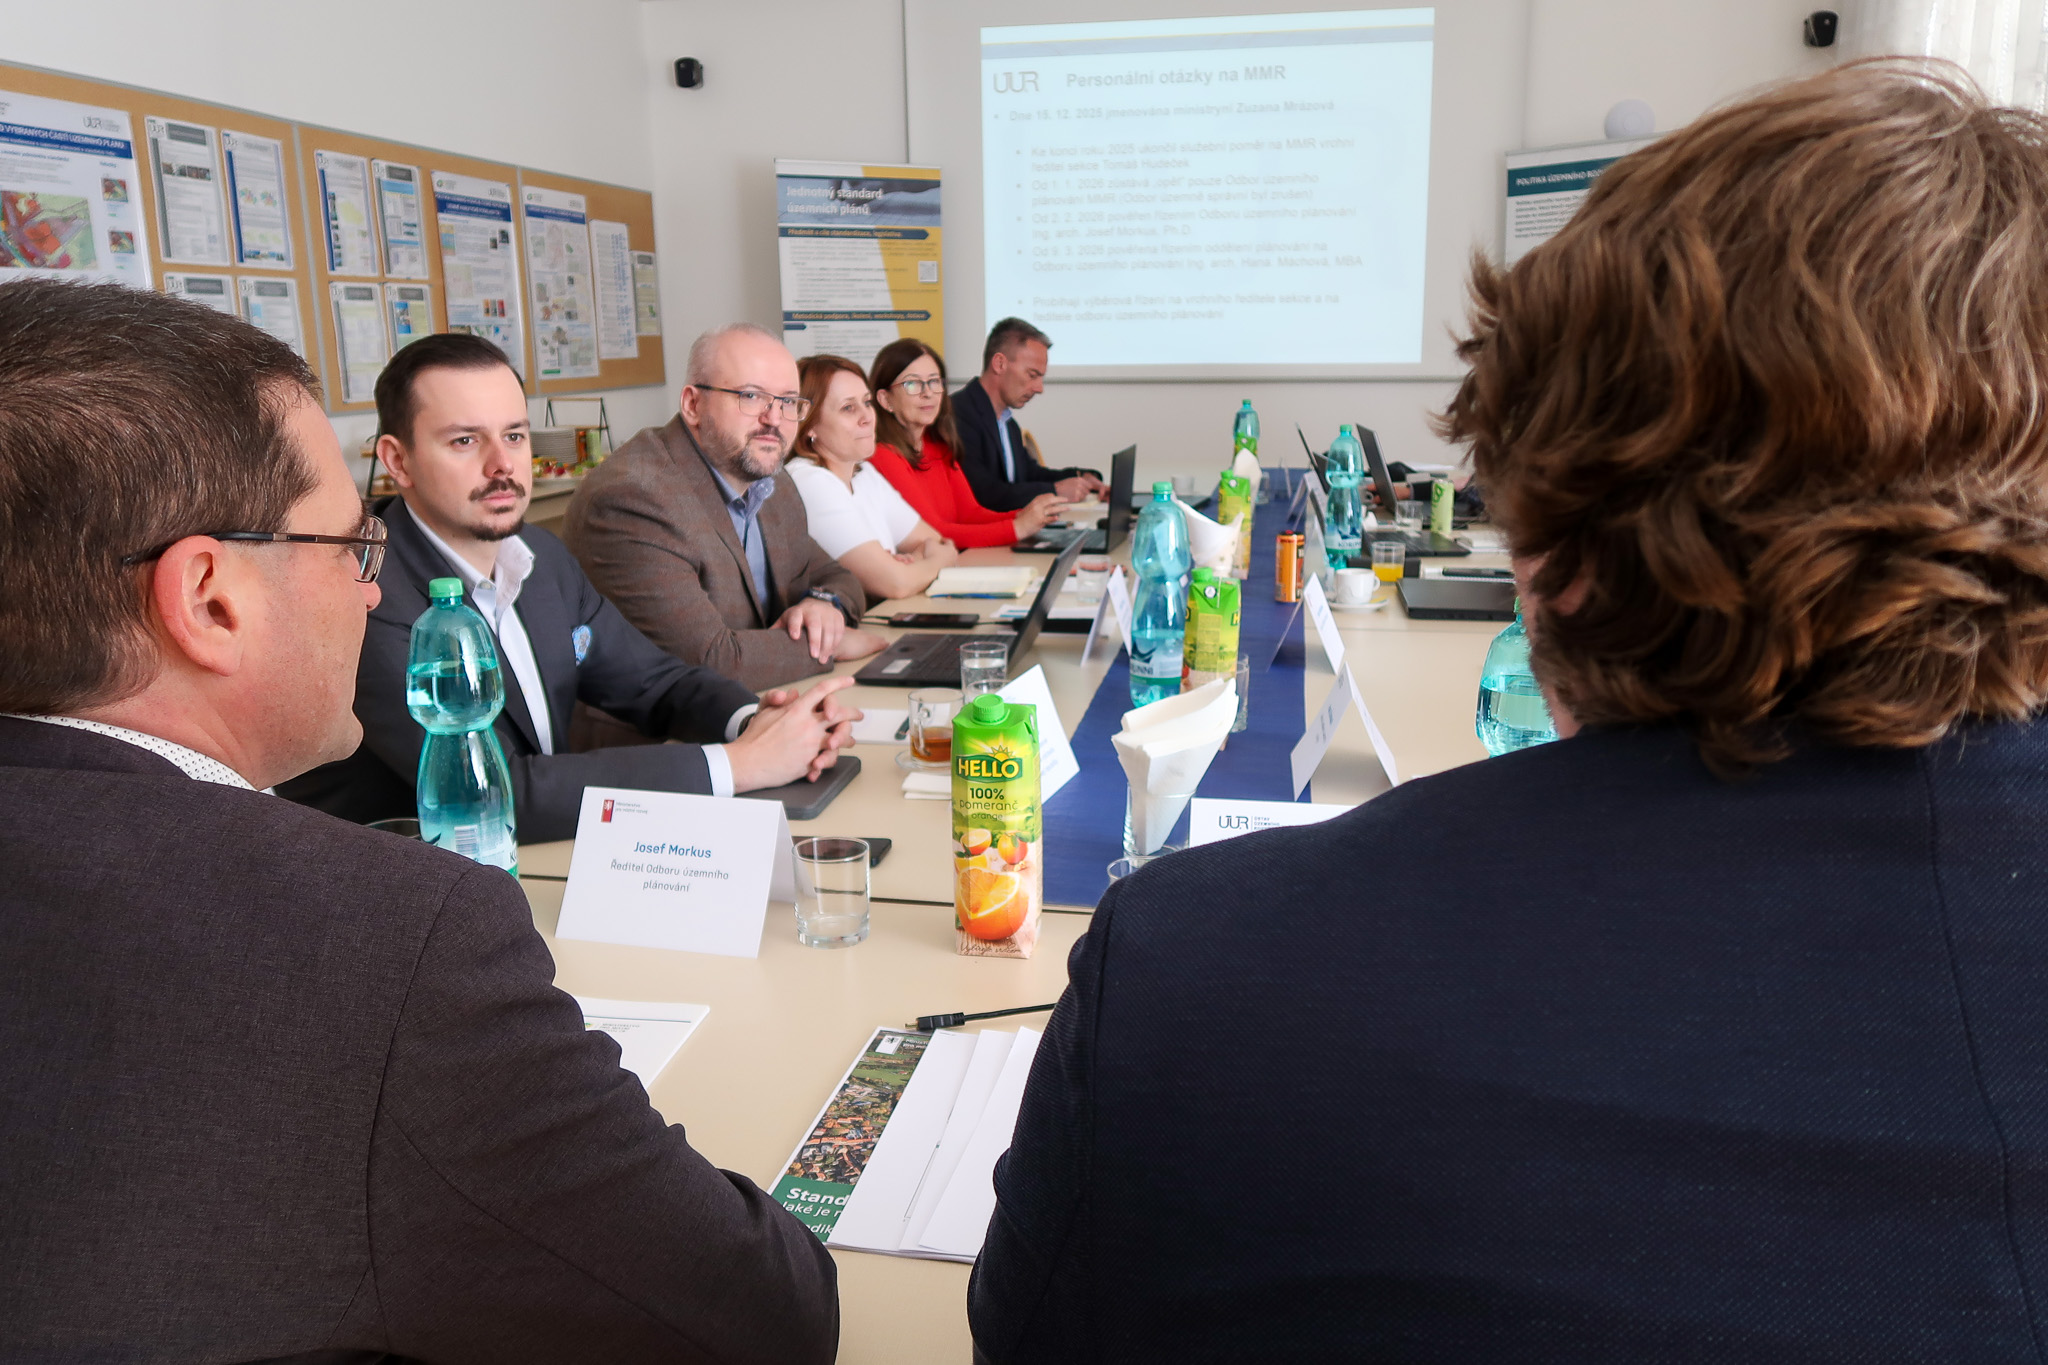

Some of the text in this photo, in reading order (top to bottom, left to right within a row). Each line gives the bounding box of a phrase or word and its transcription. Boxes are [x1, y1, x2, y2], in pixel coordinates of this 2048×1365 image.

[1066, 65, 1286, 88] Personální otázky na MMR
[1009, 110, 1032, 121] Dne
[1056, 109, 1071, 119] 12.
[1076, 107, 1103, 119] 2025
[1105, 106, 1170, 120] jmenována
[1173, 104, 1233, 116] ministryní
[1236, 103, 1280, 113] Zuzana
[1283, 100, 1335, 111] Mrázová
[1031, 146, 1046, 157] Ke
[1049, 145, 1078, 156] konci
[1080, 145, 1104, 155] roku
[1108, 143, 1135, 154] 2025
[1229, 140, 1265, 153] poměr
[1268, 141, 1283, 150] na
[1286, 137, 1317, 149] MMR
[1319, 137, 1355, 149] vrchní
[1067, 160, 1099, 171] sekce
[1103, 158, 1138, 170] Tomáš
[1141, 156, 1190, 169] Hudeček
[1032, 179, 1048, 191] Od
[1188, 177, 1222, 188] pouze
[1225, 174, 1259, 185] Odbor
[1263, 172, 1320, 185] územního
[1516, 176, 1547, 187] POLITIKA
[786, 186, 884, 200] Jednotný standard
[1032, 194, 1084, 207] plánování
[1086, 192, 1116, 204] MMR
[787, 203, 838, 214] územních
[1032, 212, 1048, 224] Od
[1199, 207, 1241, 220] Odboru
[1243, 207, 1298, 219] územního
[1301, 206, 1357, 219] plánování
[1085, 225, 1115, 238] Josef
[1032, 245, 1048, 257] Od
[1313, 242, 1328, 252] na
[1032, 260, 1073, 272] Odboru
[1335, 255, 1363, 267] MBA
[1168, 295, 1182, 305] na
[1278, 293, 1312, 304] sekce
[1314, 295, 1322, 304] a
[1325, 294, 1340, 304] na
[1074, 310, 1112, 321] odboru
[958, 758, 1020, 779] HELLO
[969, 787, 1005, 800] 100%
[959, 799, 1019, 811] pomeranč
[971, 812, 1004, 822] orange
[633, 841, 712, 859] Josef Morkus
[610, 858, 729, 880] Ředitel Odboru územního
[642, 879, 691, 893] plánování
[786, 1187, 852, 1206] Stand
[813, 1206, 831, 1217] je
